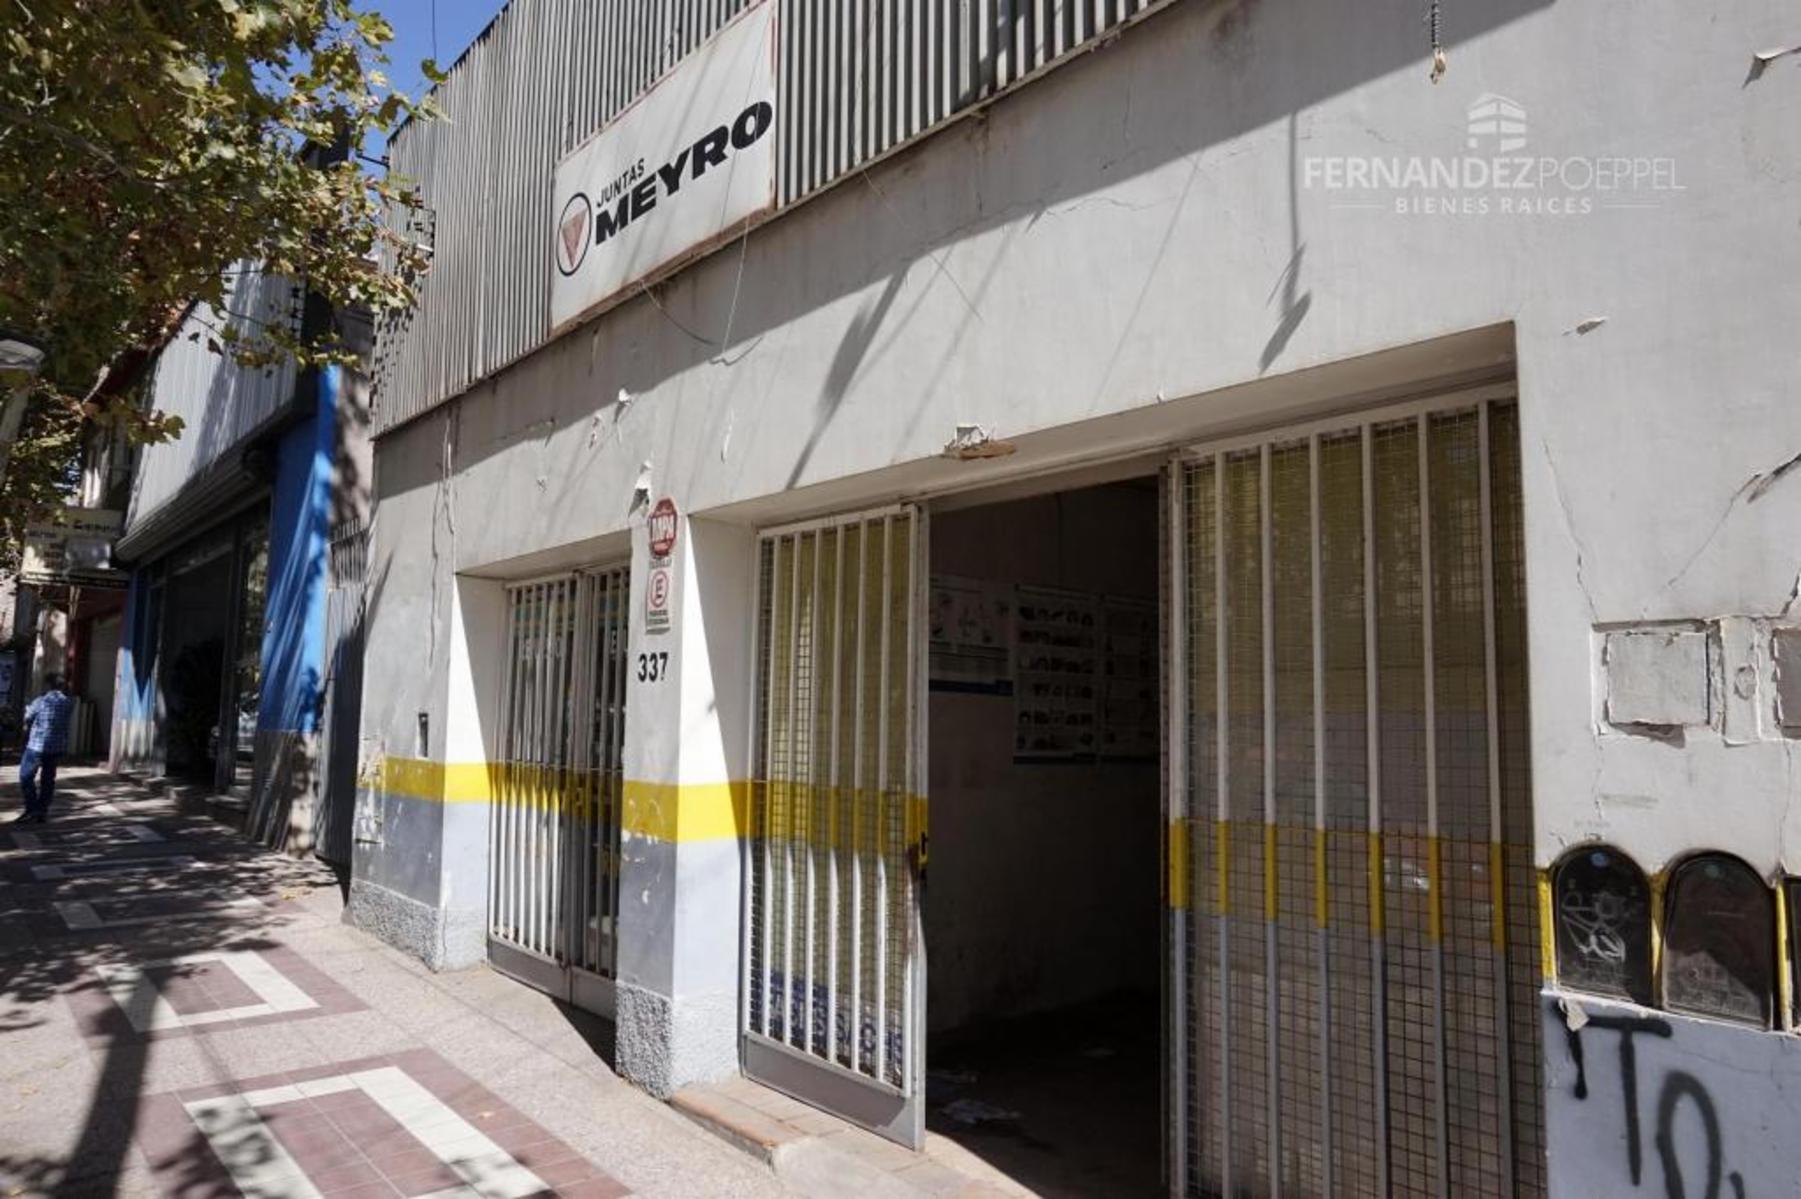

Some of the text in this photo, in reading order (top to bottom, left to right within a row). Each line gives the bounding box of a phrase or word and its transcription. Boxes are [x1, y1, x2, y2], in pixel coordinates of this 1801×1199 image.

[595, 101, 773, 246] MEYRO
[596, 157, 645, 207] JUNTAS
[637, 652, 668, 683] 337
